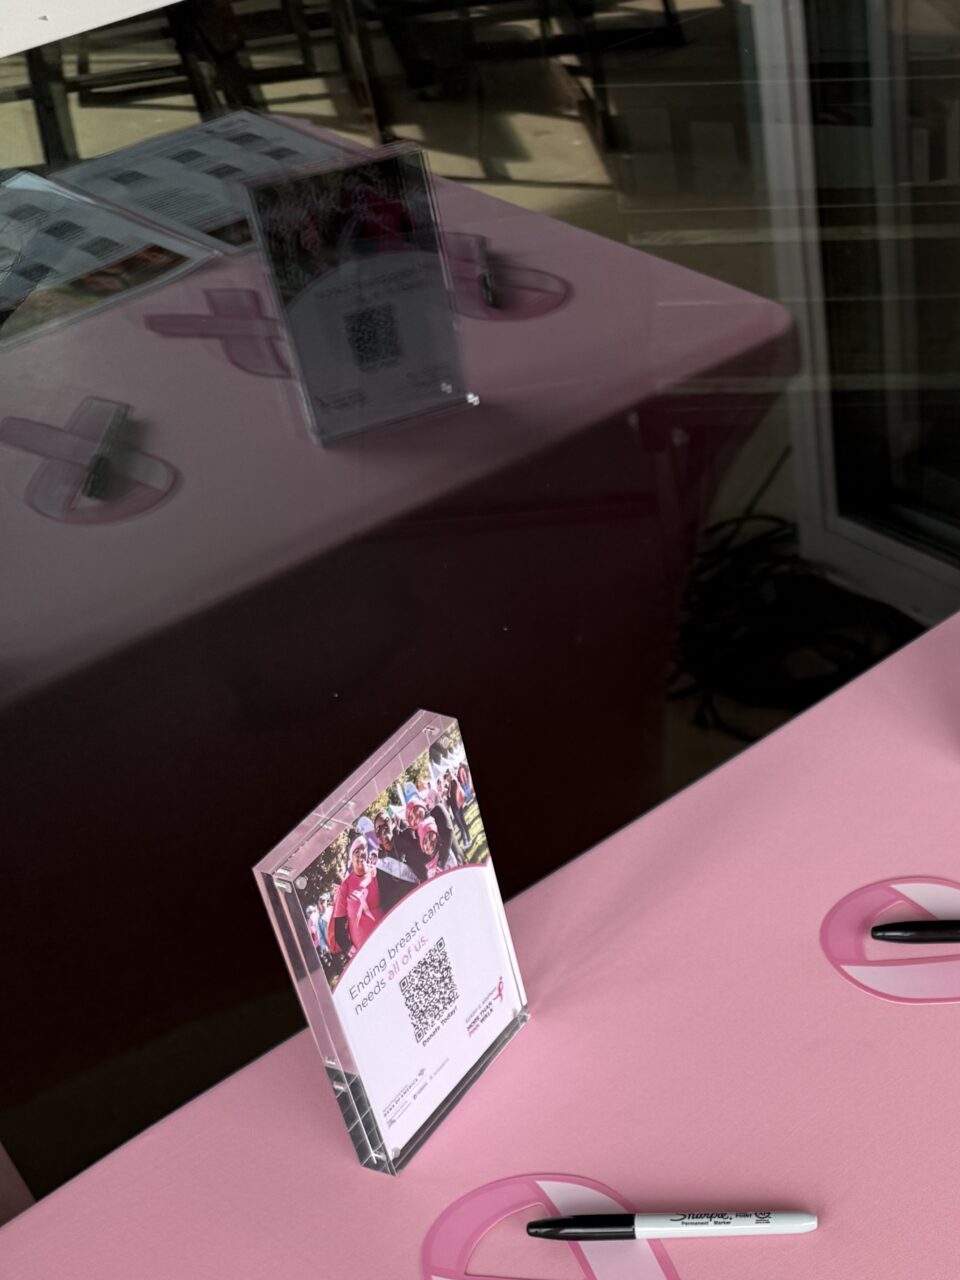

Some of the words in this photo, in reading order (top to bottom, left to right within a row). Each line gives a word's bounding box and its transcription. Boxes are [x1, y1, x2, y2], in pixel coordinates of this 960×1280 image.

[349, 958, 386, 1000] Ending
[388, 922, 420, 959] breast
[422, 886, 454, 924] cancer
[354, 978, 386, 1015] needs
[388, 961, 399, 981] all
[402, 948, 413, 965] of
[416, 936, 429, 951] us.
